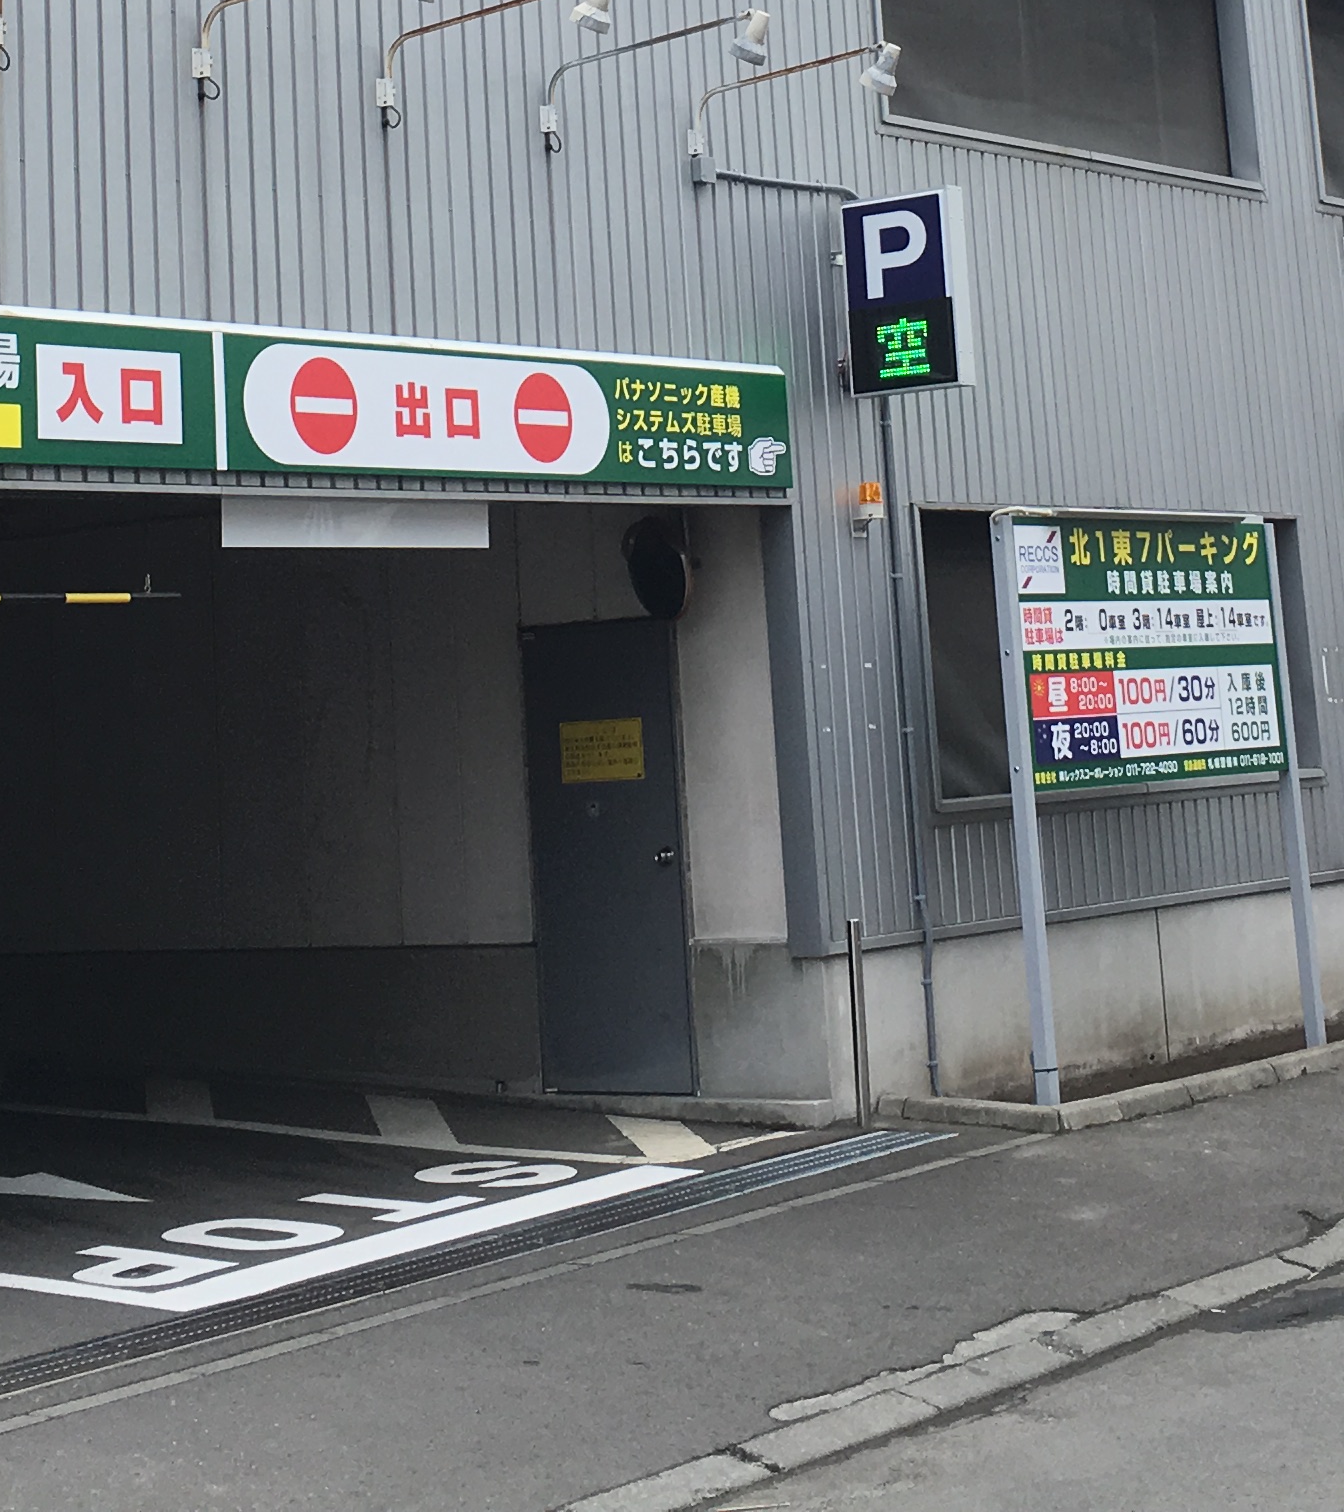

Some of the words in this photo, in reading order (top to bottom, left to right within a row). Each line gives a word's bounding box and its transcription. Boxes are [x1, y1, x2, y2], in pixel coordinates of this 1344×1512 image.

[862, 210, 927, 300] P
[876, 318, 931, 379] 空
[56, 362, 165, 425] 入口
[615, 377, 741, 409] パナソニック産機
[394, 381, 481, 441] 出口
[616, 408, 742, 438] システムズ駐車場
[618, 437, 743, 473] はこちらです
[1019, 545, 1059, 563] RECCS
[1068, 527, 1260, 566] 北1東7パーキング
[1106, 570, 1234, 595] 時間貸駐車場案内
[1023, 607, 1053, 626] 時間貸
[1025, 626, 1064, 646] 駐車場は
[1032, 651, 1127, 671] 時間貸駐車場料金
[1047, 676, 1069, 713] 昼
[1227, 671, 1266, 693] 入庫後
[1078, 694, 1114, 710] 20:00
[1228, 696, 1268, 717] 12時間
[1050, 722, 1073, 761] 夜
[1073, 720, 1109, 738] 20:00
[1231, 720, 1271, 743] 600円
[72, 1160, 578, 1287] STOP
